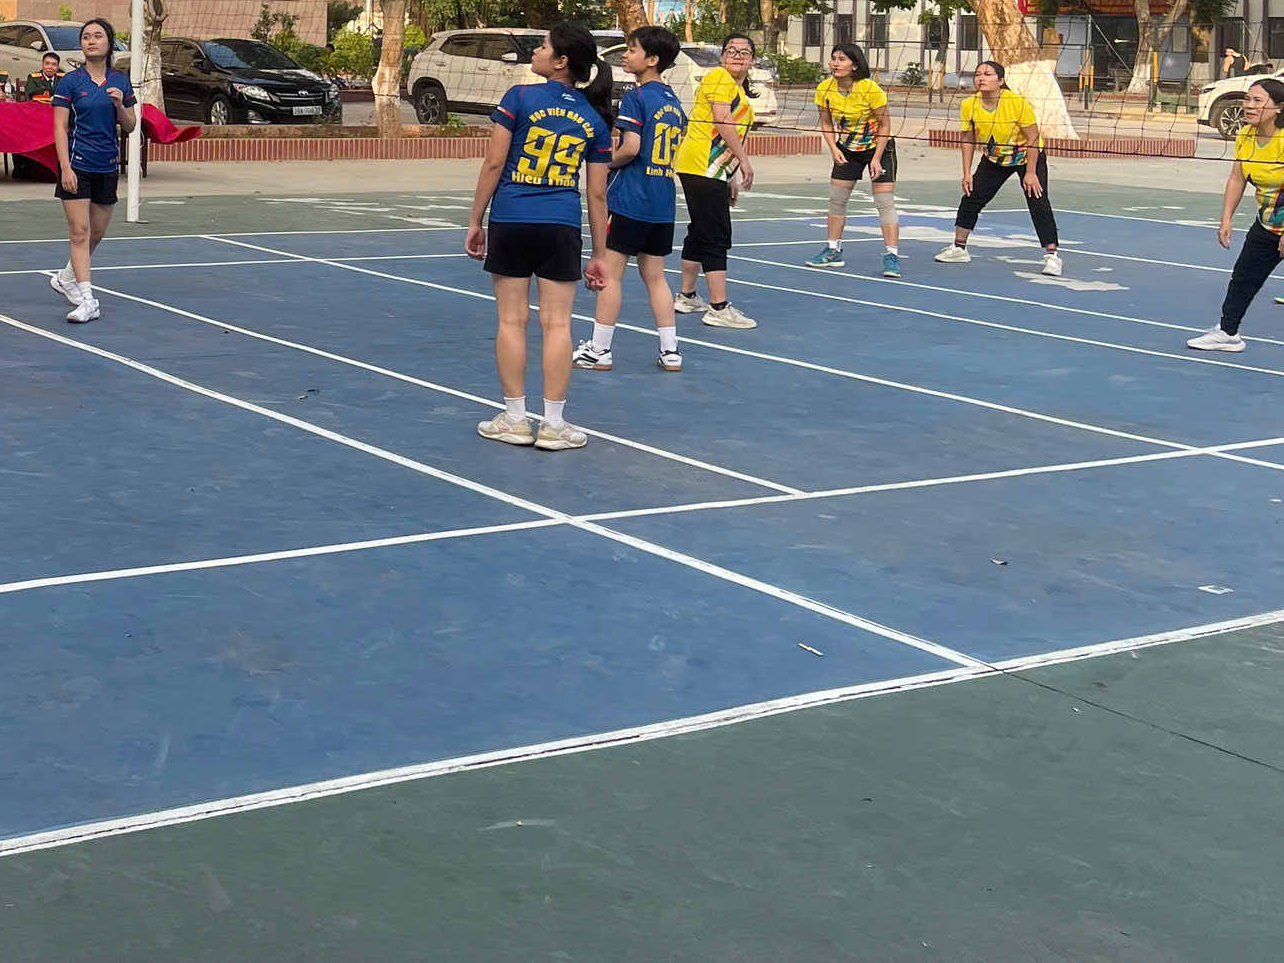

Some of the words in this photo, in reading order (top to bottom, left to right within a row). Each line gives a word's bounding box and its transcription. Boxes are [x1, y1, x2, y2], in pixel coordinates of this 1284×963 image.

[529, 109, 546, 123] HỌC
[547, 107, 566, 117] VIỆN
[517, 126, 586, 179] 99
[646, 166, 664, 176] Linh
